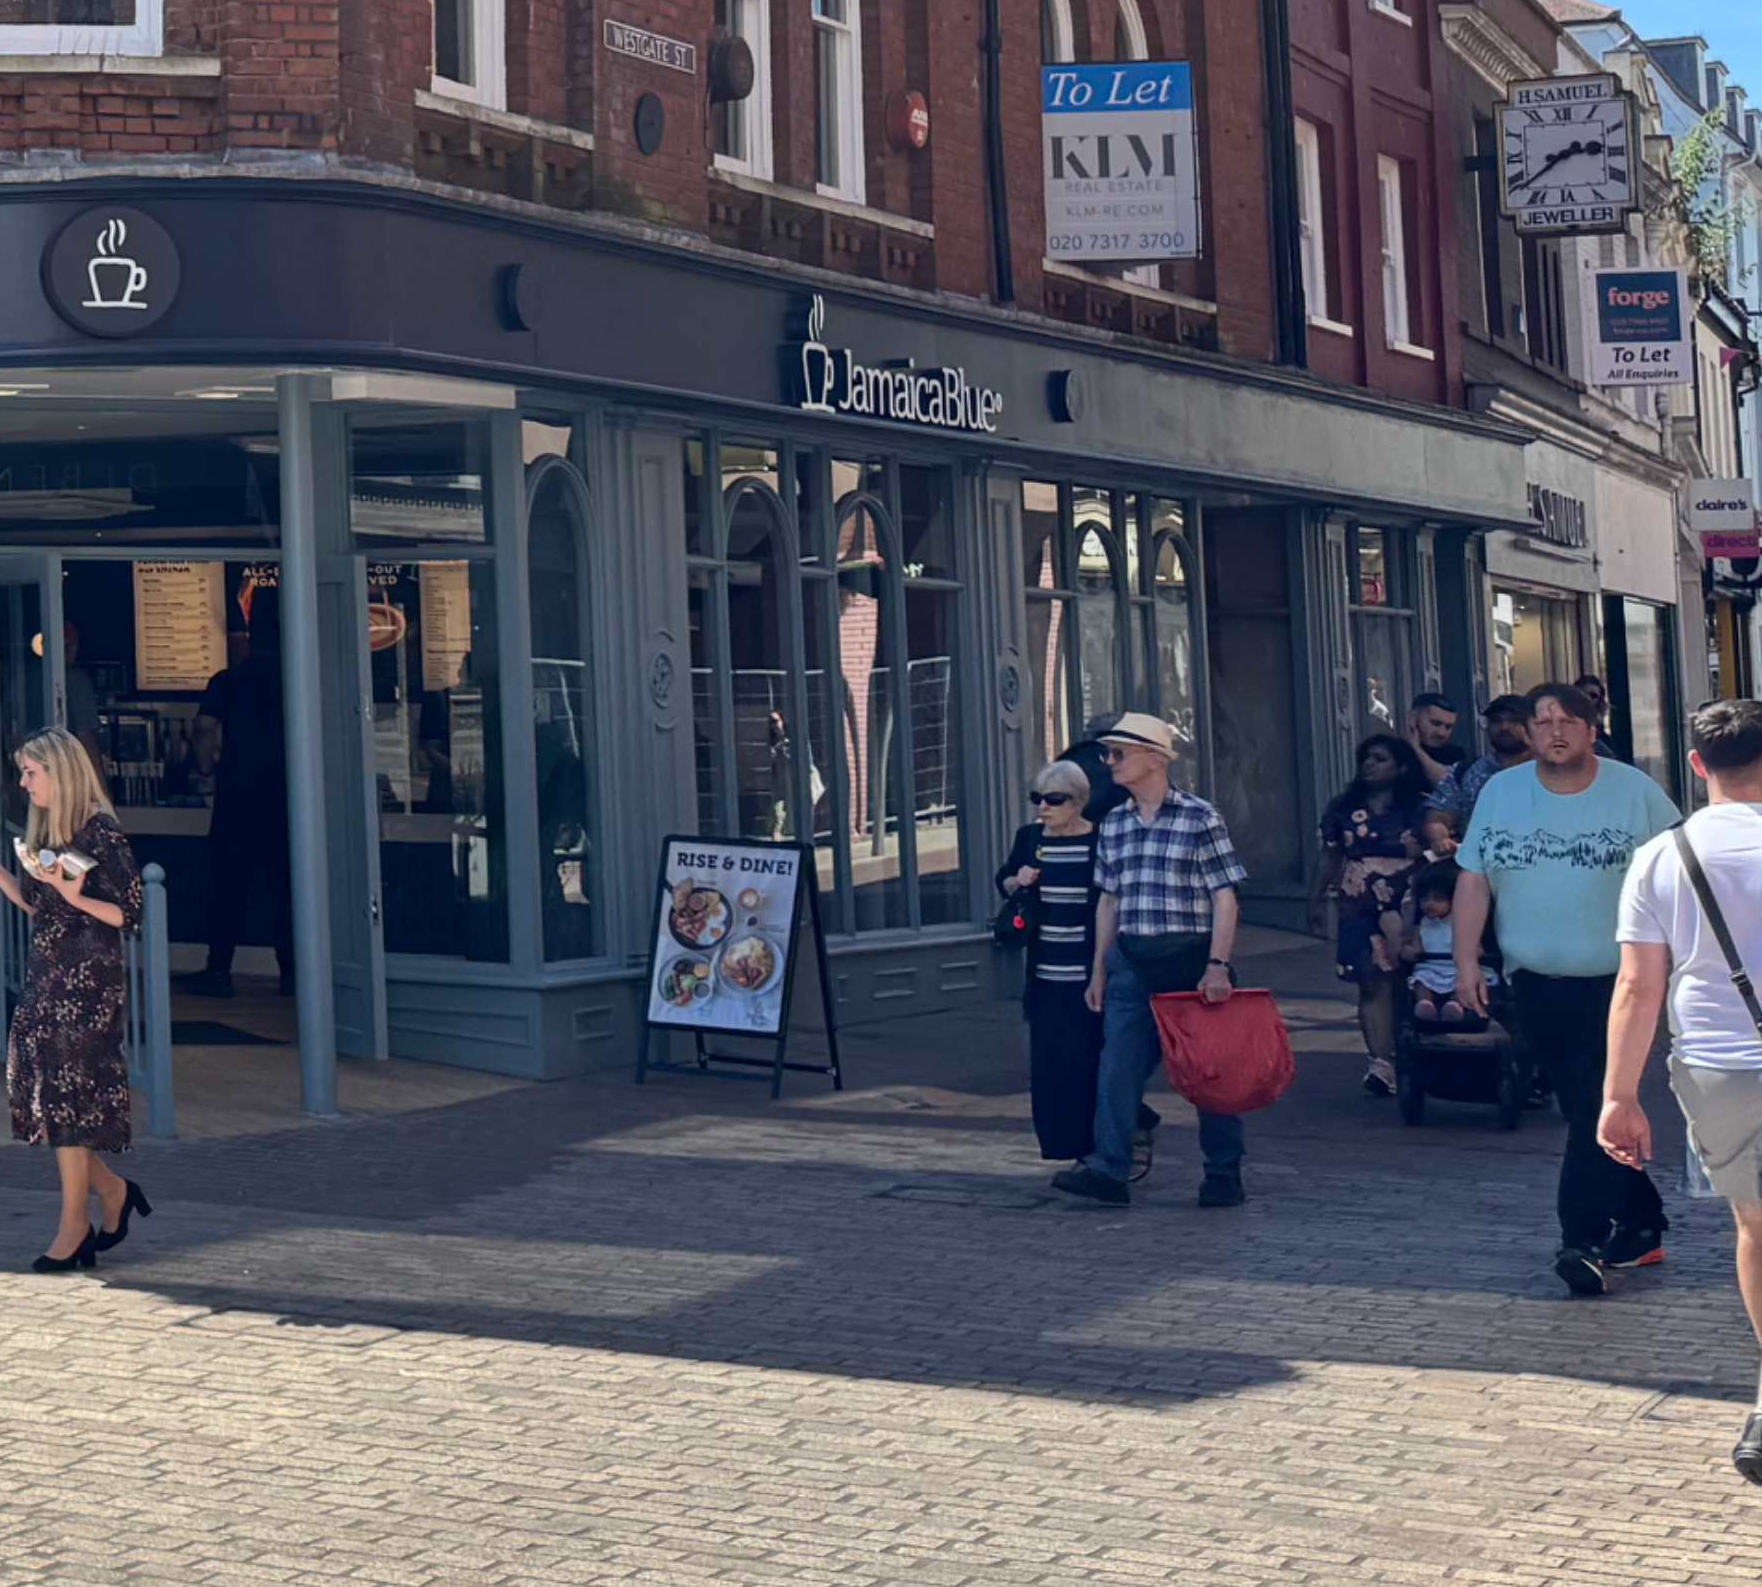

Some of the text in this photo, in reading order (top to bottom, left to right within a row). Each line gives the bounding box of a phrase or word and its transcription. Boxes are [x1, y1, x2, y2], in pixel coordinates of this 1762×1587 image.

[613, 25, 688, 68] WESTGATE ST
[1048, 70, 1174, 107] To Let
[1049, 133, 1177, 179] KLM
[1065, 180, 1165, 193] REAL ESTATE
[1523, 207, 1614, 226] JEWELLER
[1049, 232, 1185, 251] 020 7317 3700
[1608, 286, 1671, 310] forge
[1611, 347, 1671, 364] To Let
[1607, 368, 1680, 380] All Enquiries
[677, 852, 793, 876] RISE & DINE!
